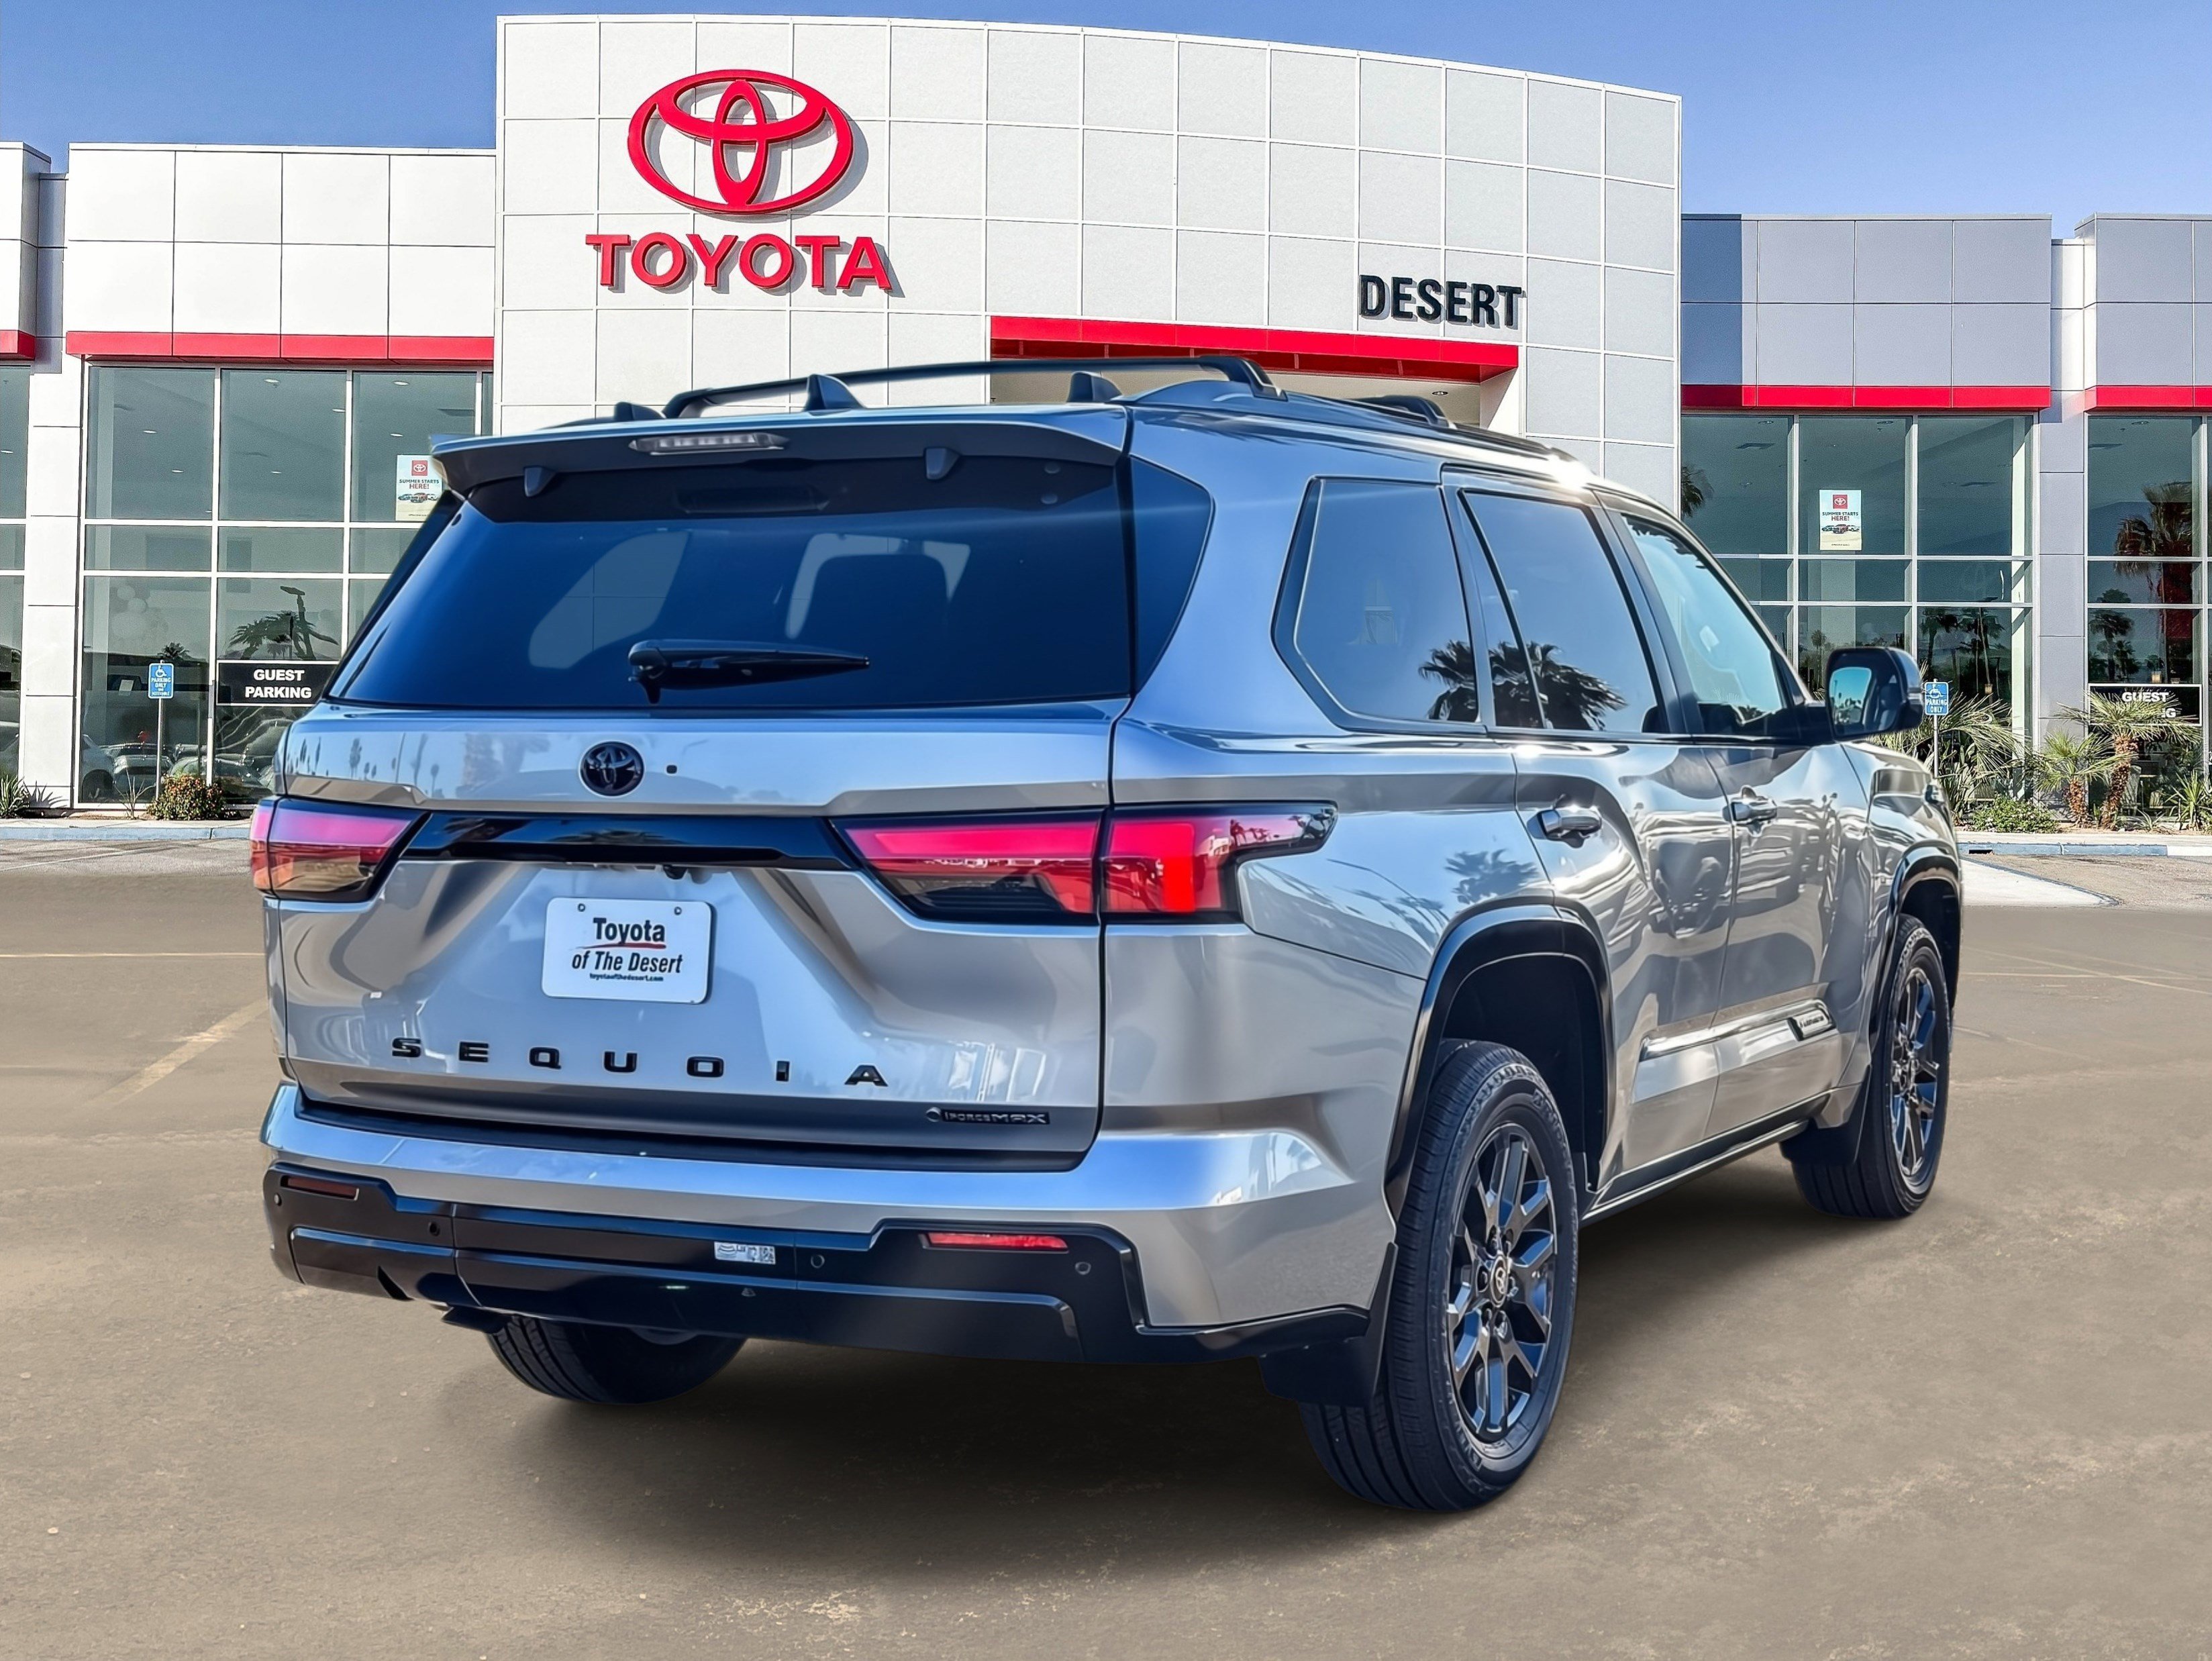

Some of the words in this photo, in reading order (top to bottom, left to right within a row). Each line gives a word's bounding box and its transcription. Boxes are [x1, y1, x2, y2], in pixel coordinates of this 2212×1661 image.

[585, 232, 893, 291] TOYOTA
[1359, 274, 1522, 327] DESERT
[253, 669, 305, 681] GUEST
[245, 686, 312, 699] PARKING
[2121, 691, 2169, 703] GUEST
[593, 917, 666, 945] Toyota
[572, 950, 591, 969] of
[595, 951, 623, 970] The
[628, 952, 683, 973] Desert
[392, 1038, 889, 1087] SEQUOIA
